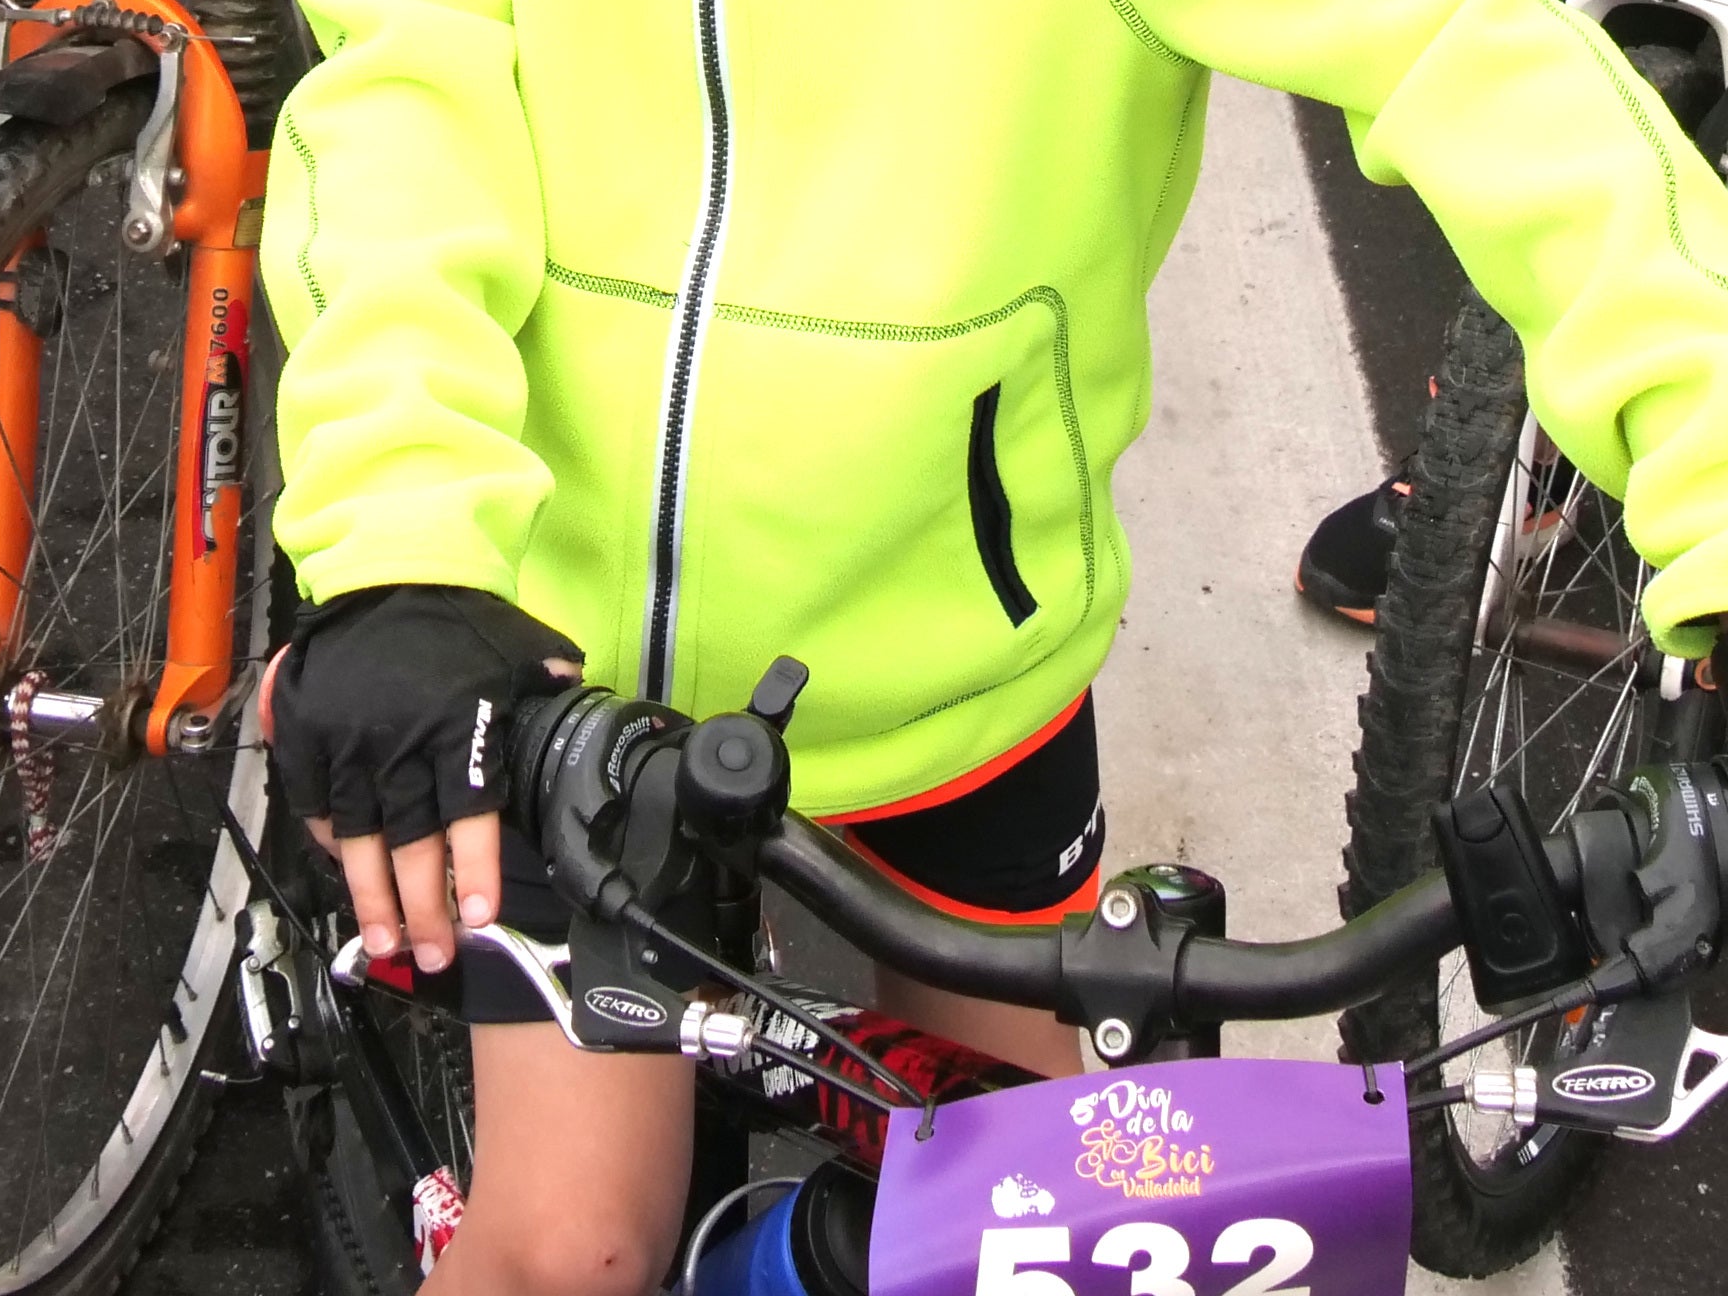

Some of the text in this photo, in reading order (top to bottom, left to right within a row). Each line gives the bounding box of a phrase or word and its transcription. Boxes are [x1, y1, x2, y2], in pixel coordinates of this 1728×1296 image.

[554, 737, 565, 751] 2
[608, 716, 650, 776] RevoShift
[593, 994, 661, 1021] TEKTRO
[1099, 1080, 1171, 1118] Día
[1562, 1075, 1646, 1092] TEKTRO
[1127, 1098, 1194, 1135] de la
[1135, 1135, 1215, 1179] Bici
[975, 1218, 1314, 1296] 532
